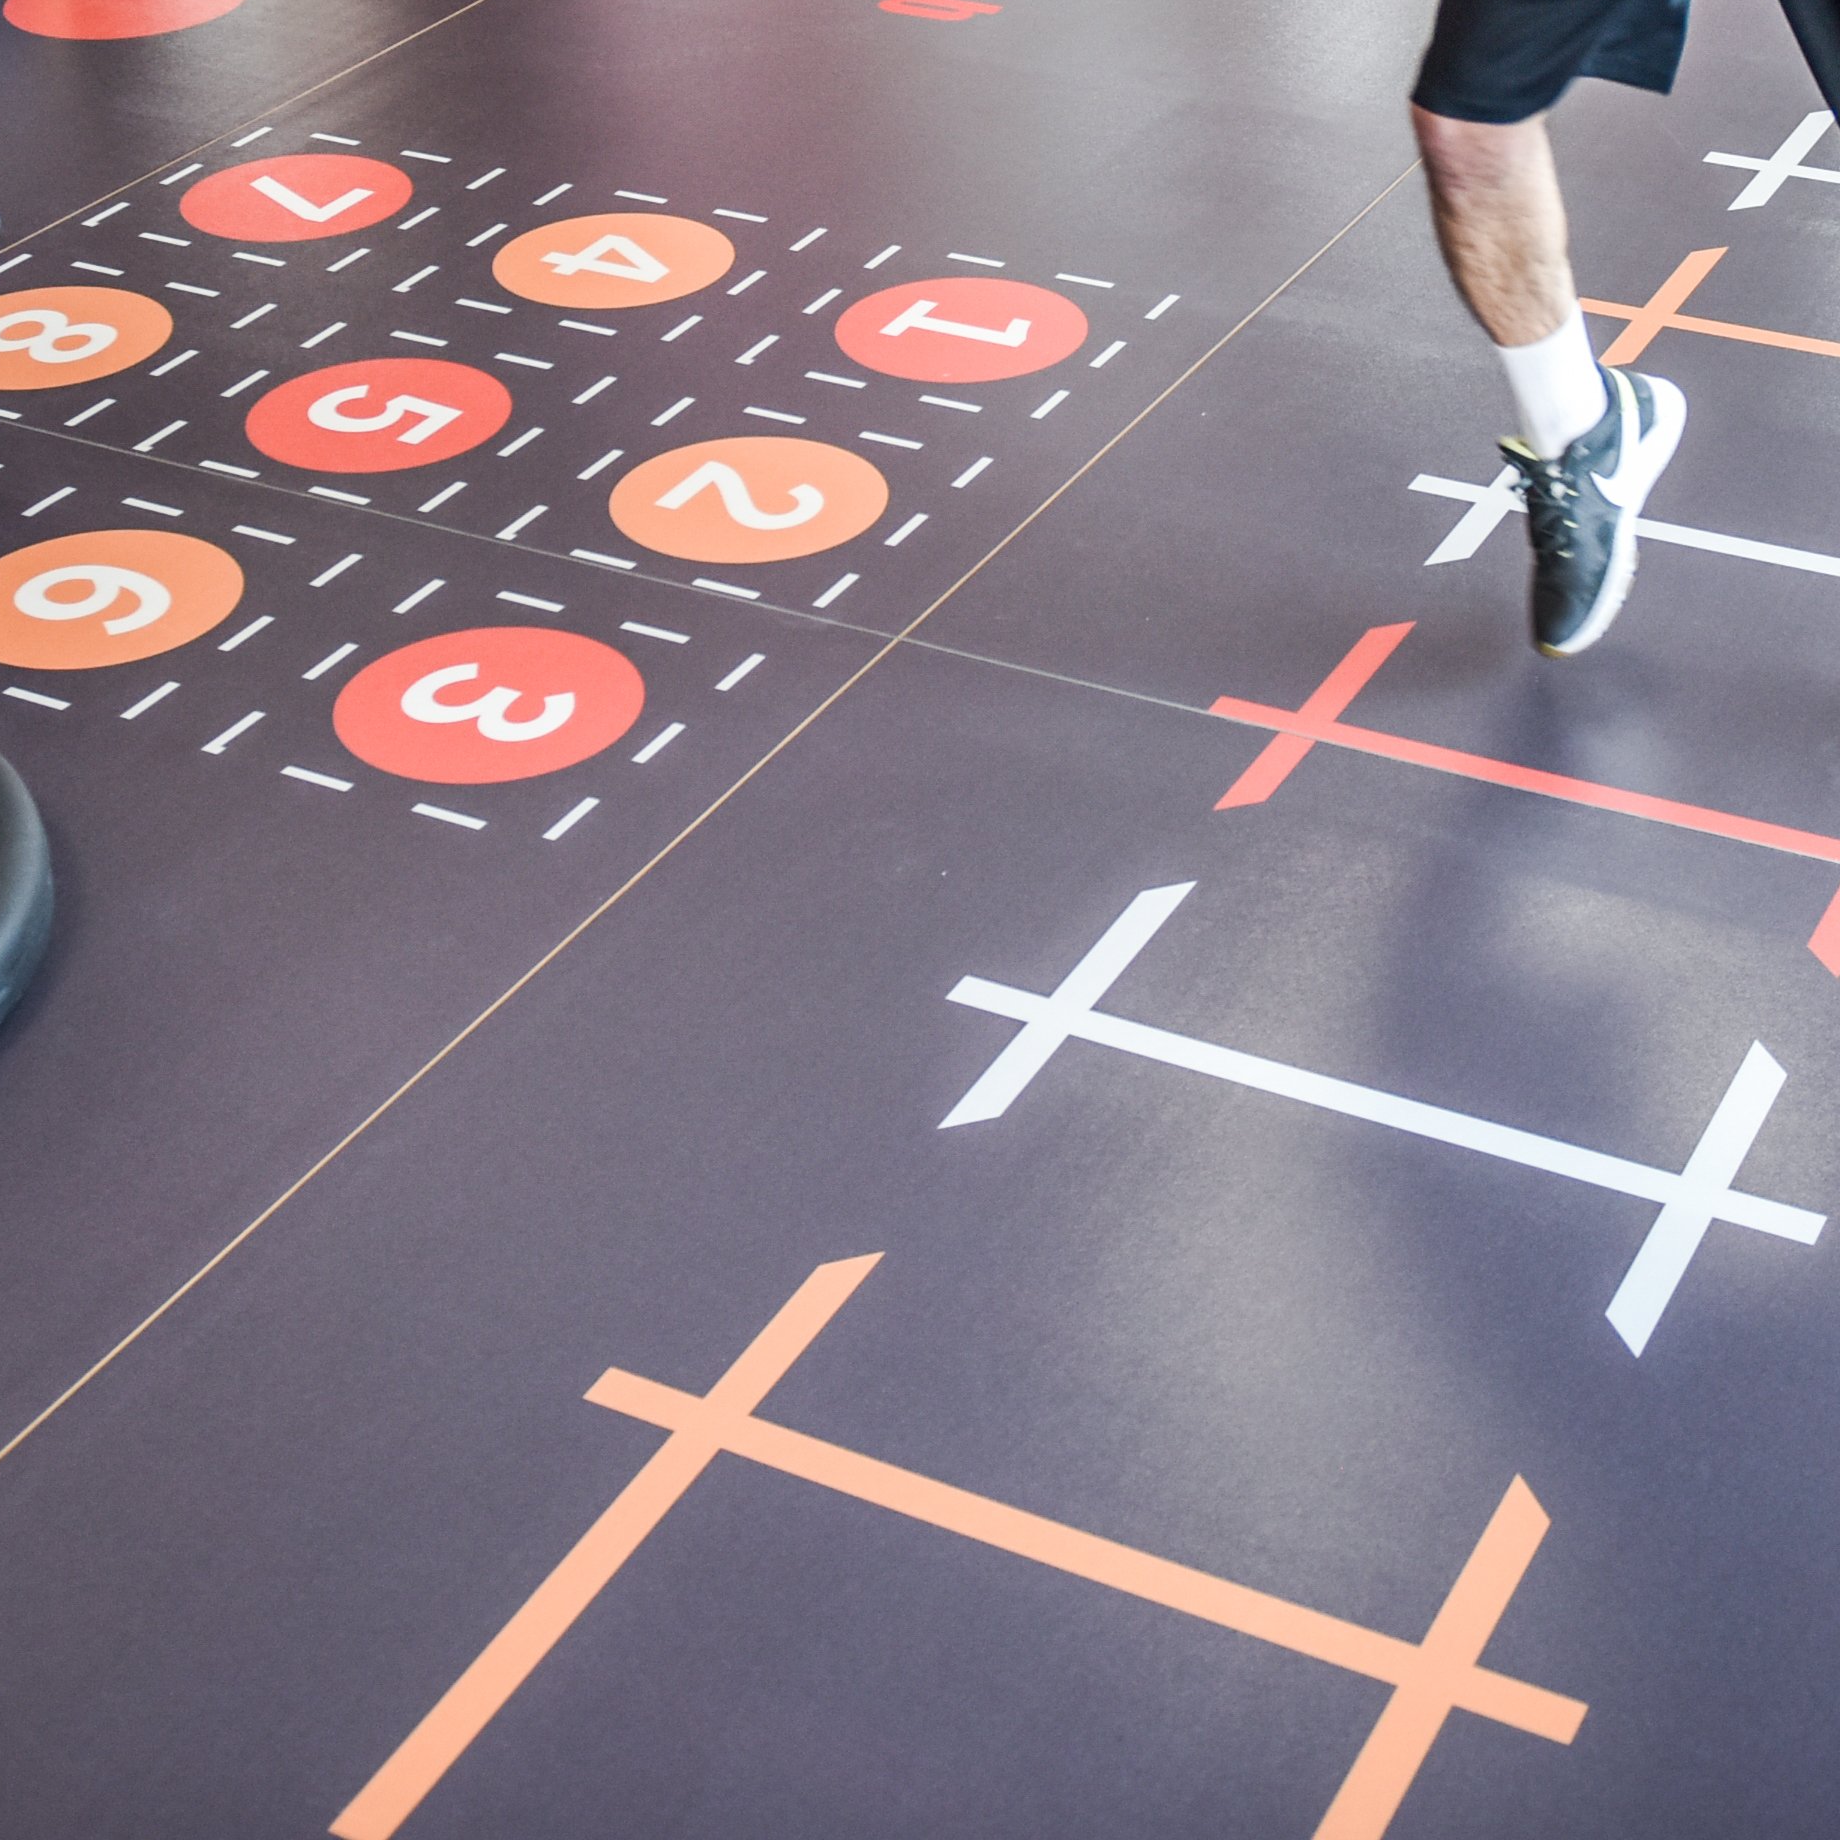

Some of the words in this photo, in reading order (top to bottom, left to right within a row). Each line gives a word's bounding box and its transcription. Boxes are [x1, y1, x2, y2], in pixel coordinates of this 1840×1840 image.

[252, 174, 374, 224] 7
[542, 234, 670, 285] 4
[879, 299, 1032, 348] 1
[308, 384, 465, 445] 5
[655, 461, 825, 531] 2
[13, 564, 171, 636] 6
[400, 662, 576, 744] 3
